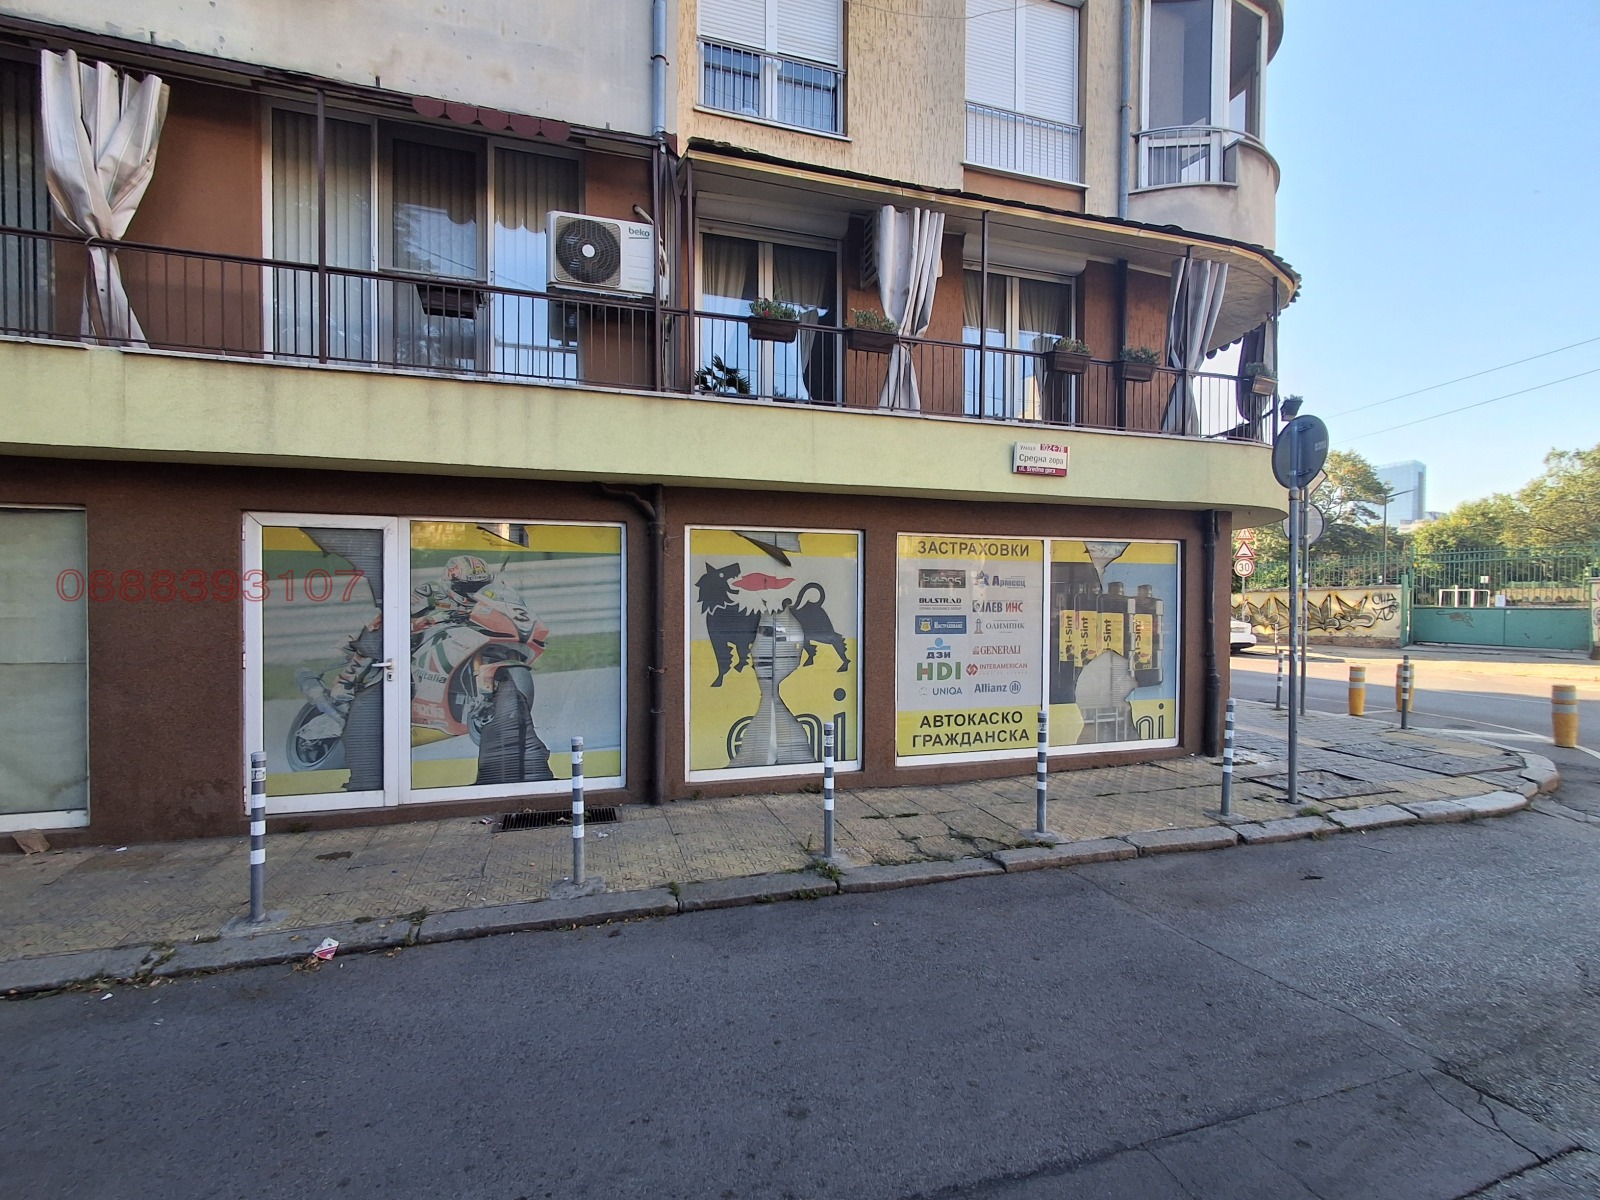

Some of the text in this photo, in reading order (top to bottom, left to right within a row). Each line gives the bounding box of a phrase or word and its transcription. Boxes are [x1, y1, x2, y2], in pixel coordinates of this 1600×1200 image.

[628, 227, 650, 237] beko
[1019, 454, 1063, 465] Средна гора
[918, 540, 1029, 557] ЗАСТРАХОВКИ
[1239, 562, 1250, 572] 30
[992, 575, 1026, 588] Армеец
[985, 602, 1024, 613] ЛЕВ ИНС
[512, 607, 530, 623] 3
[985, 622, 1025, 630] ОЛИМПИК
[980, 645, 1021, 655] GENERALI
[916, 661, 962, 681] HDI
[979, 662, 1028, 670] INTERAMERICAN
[932, 686, 963, 696] UNIQA
[974, 683, 1007, 693] Allianz
[919, 711, 1023, 729] АВТОКАСКО
[912, 729, 1030, 748] ГРАЖДАНСКА
